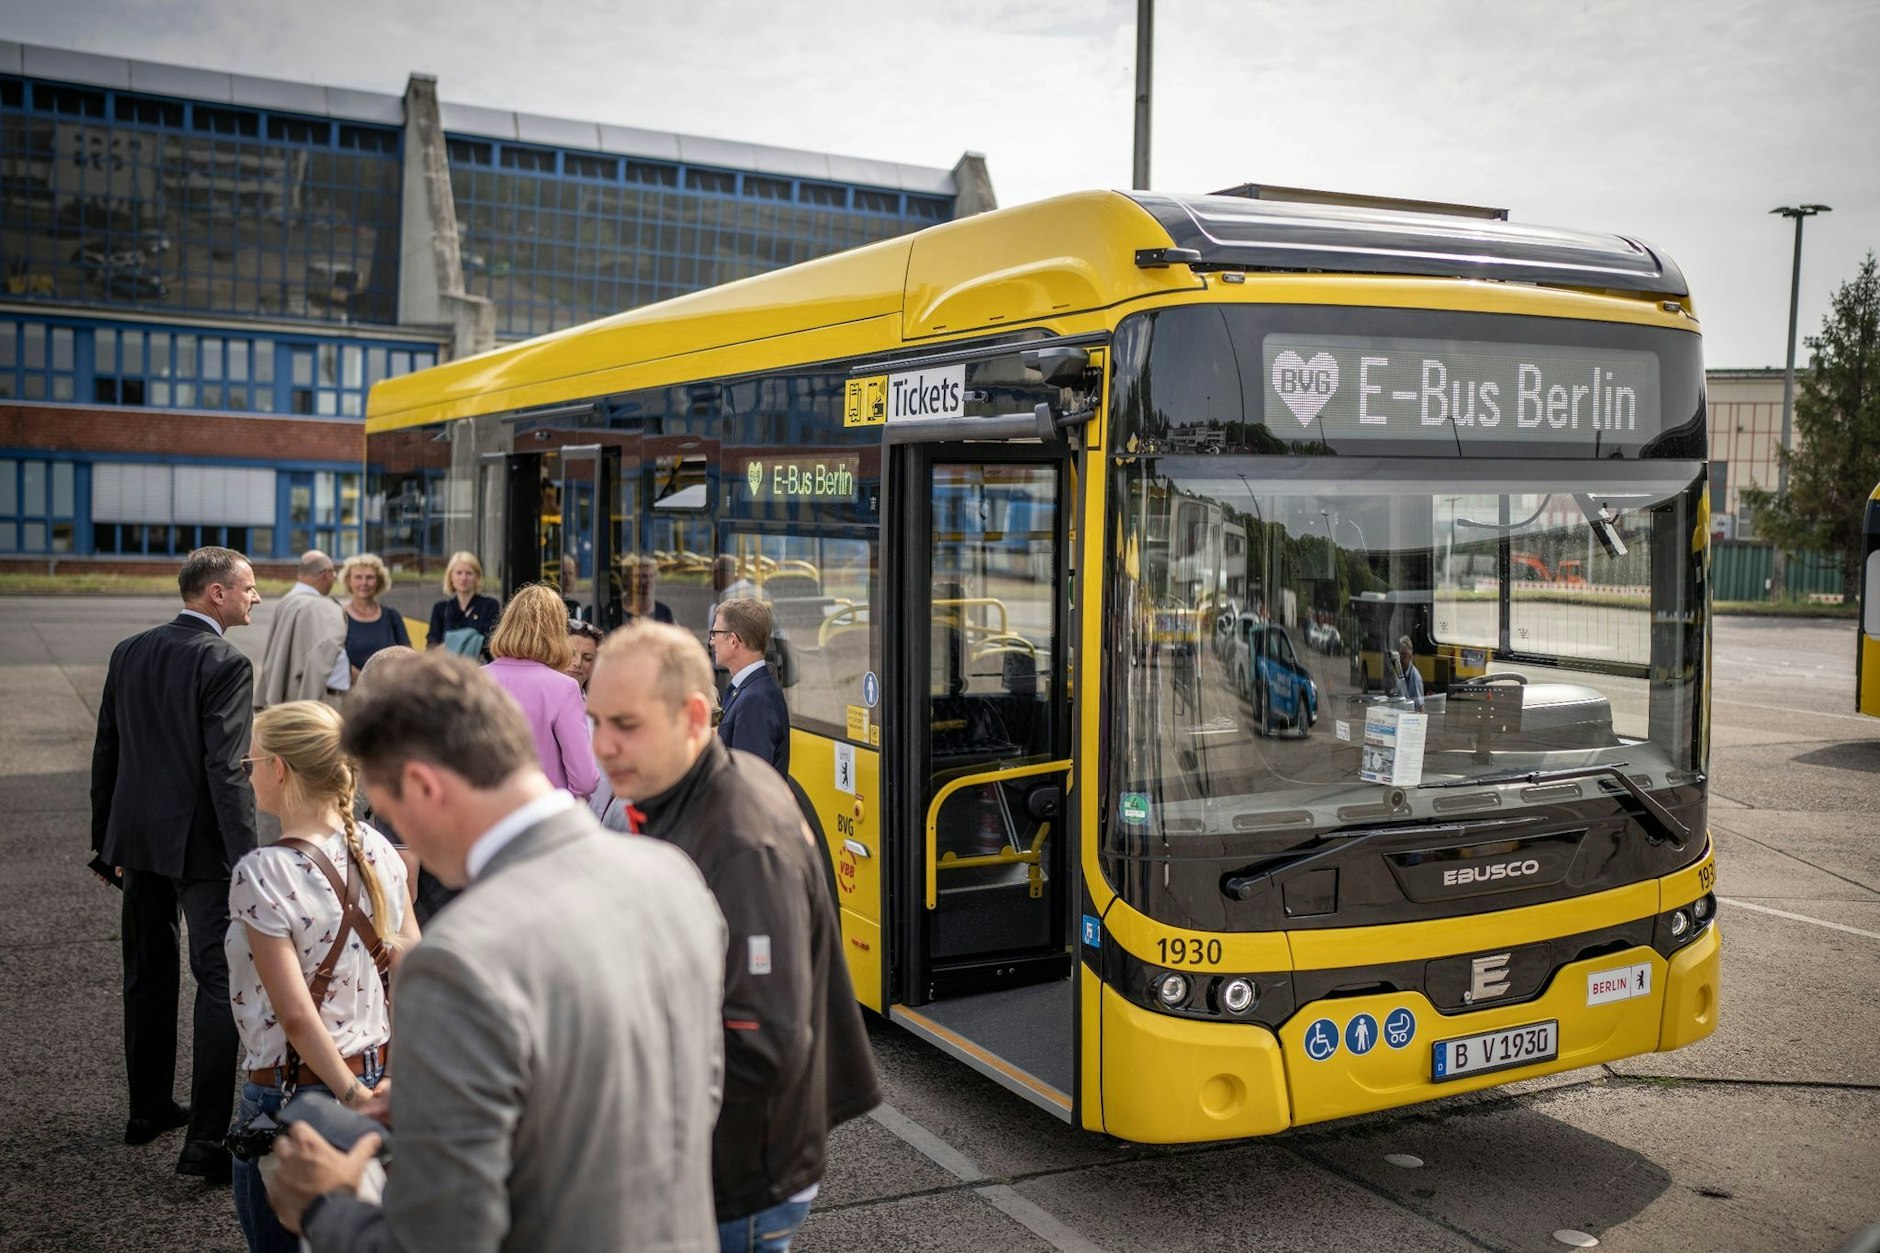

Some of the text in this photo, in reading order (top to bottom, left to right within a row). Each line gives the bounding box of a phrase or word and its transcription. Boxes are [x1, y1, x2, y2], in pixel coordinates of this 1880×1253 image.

[1281, 368, 1331, 394] BVG
[1359, 356, 1636, 430] E-Bus Berlin
[893, 375, 960, 417] Tickets
[773, 464, 812, 495] E-Bus
[815, 463, 853, 495] Berlin
[837, 813, 854, 837] BVG
[840, 859, 855, 879] VBB
[1443, 859, 1540, 886] EBUSCO
[1157, 937, 1223, 965] 1930
[1592, 976, 1628, 996] BERLIN
[1455, 1043, 1469, 1070] B
